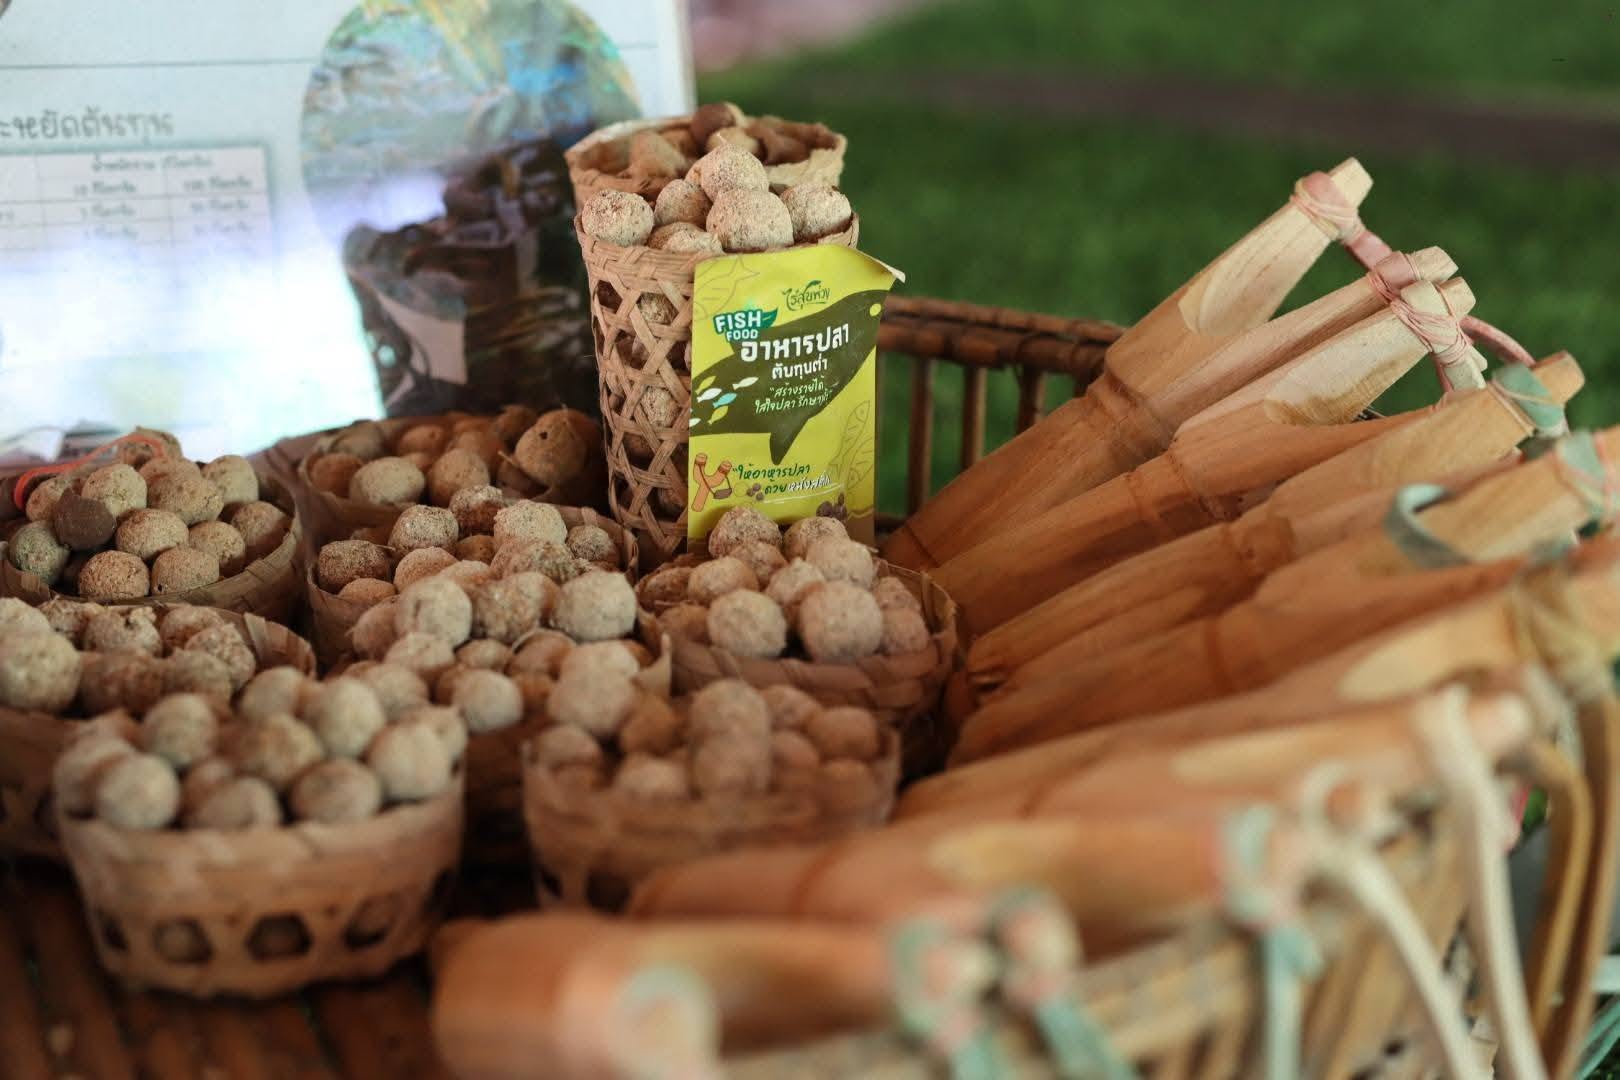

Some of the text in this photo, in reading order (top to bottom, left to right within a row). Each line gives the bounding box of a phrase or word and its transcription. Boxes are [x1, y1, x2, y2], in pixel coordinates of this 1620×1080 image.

[714, 310, 761, 333] FISH
[726, 328, 759, 342] FOOD
[740, 323, 850, 362] อาหารปลา
[771, 352, 828, 380] ต้นทุนต่ำ
